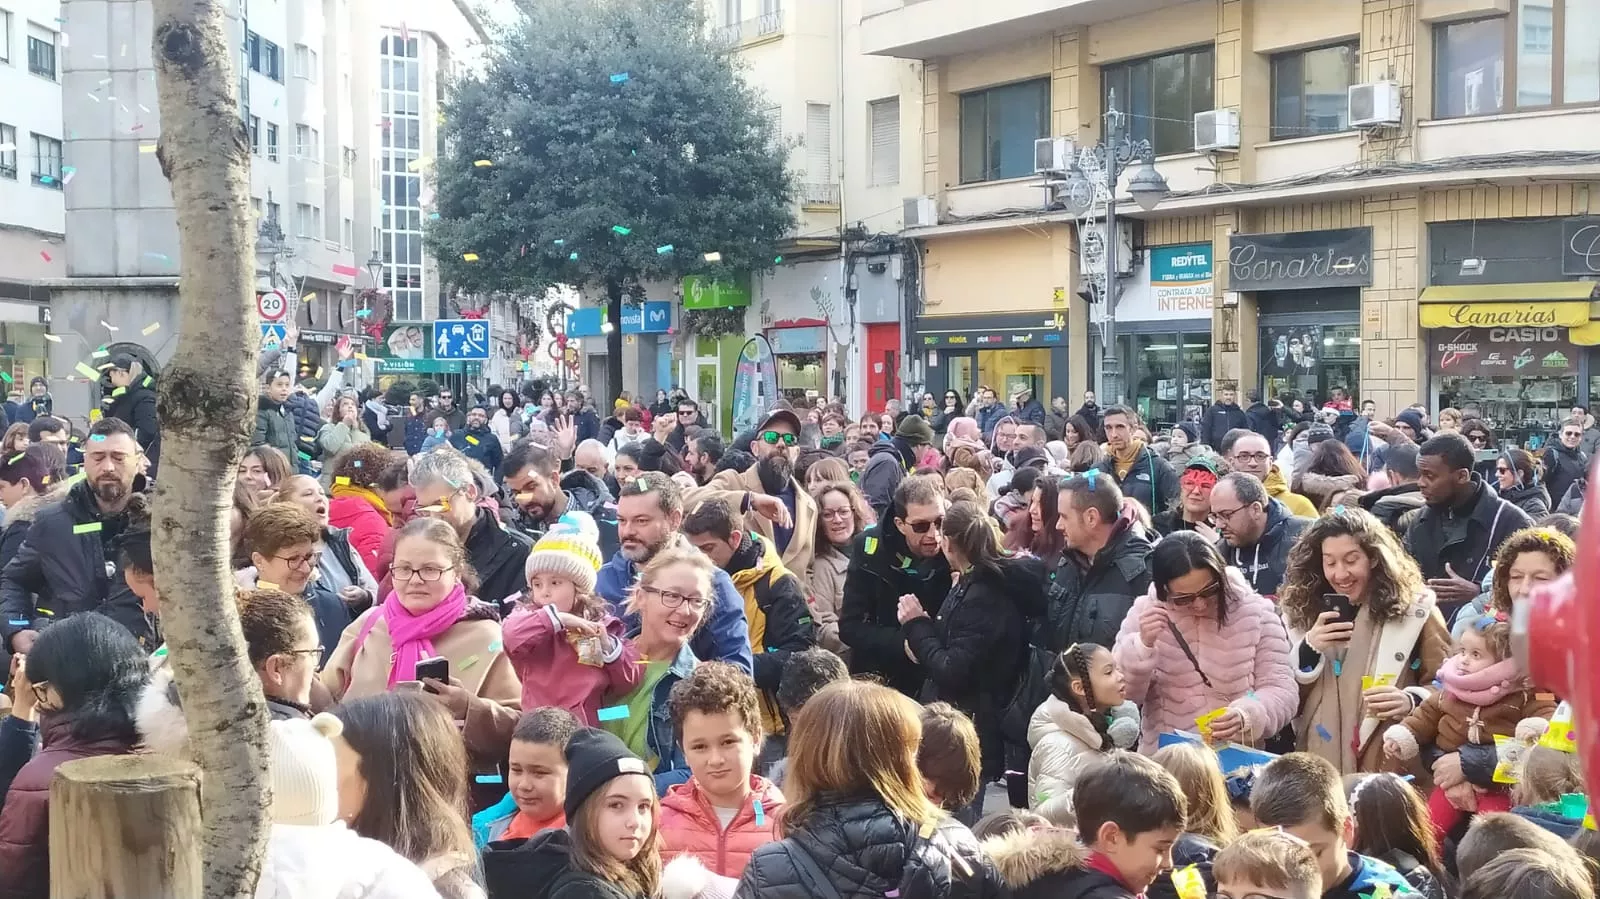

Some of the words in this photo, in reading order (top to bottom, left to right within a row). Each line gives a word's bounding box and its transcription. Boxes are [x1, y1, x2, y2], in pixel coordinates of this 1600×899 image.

[1171, 254, 1207, 267] REDYTEL
[1229, 244, 1368, 280] Canarias
[1157, 288, 1193, 298] CONTRATA
[263, 299, 281, 310] 20
[1449, 304, 1556, 325] Canarias
[1490, 328, 1558, 342] CASIO
[1438, 342, 1478, 352] G-SHOCK
